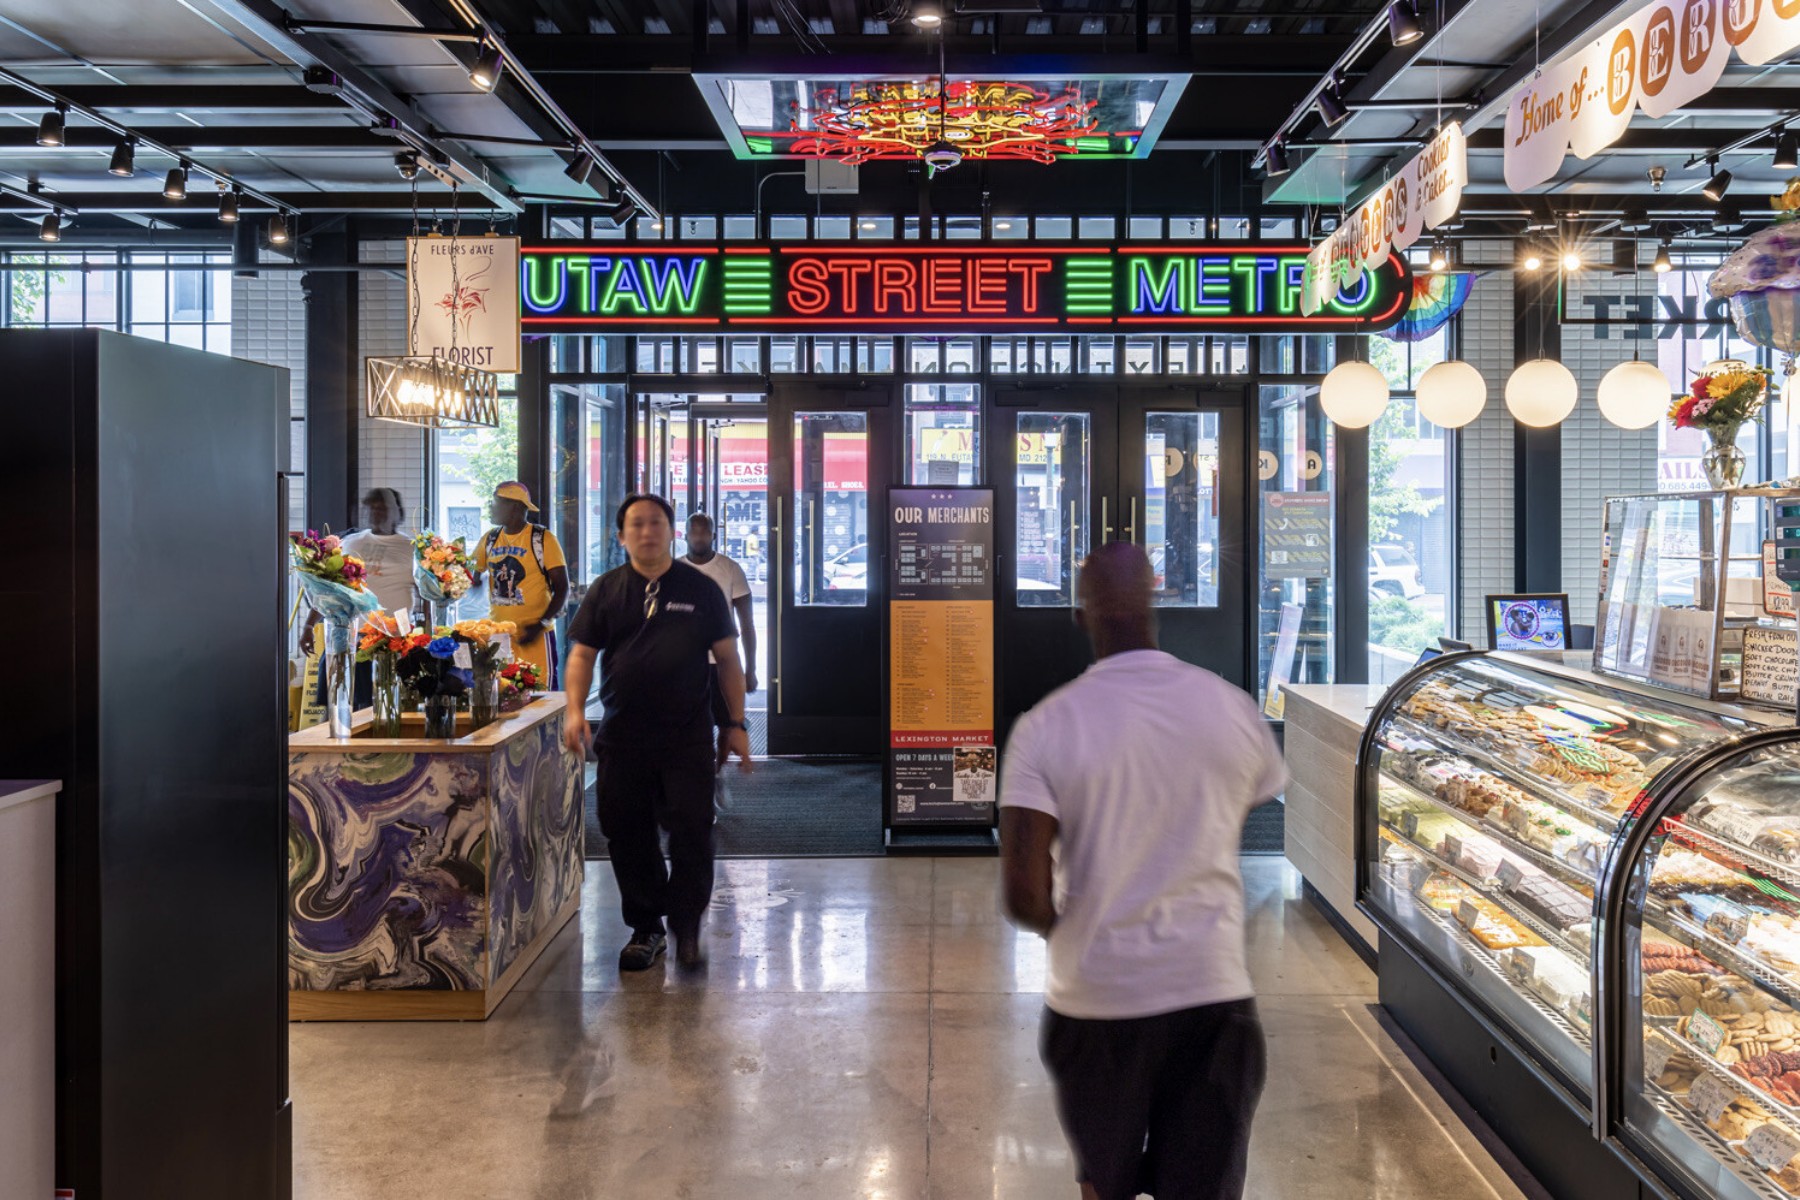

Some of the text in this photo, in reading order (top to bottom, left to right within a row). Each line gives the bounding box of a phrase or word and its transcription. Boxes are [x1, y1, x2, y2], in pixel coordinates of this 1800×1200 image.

[1515, 91, 1564, 147] Home
[1609, 0, 1797, 110] BER
[1417, 135, 1451, 182] Cookies
[431, 245, 466, 255] FLEURS
[787, 258, 1052, 314] STREET
[1019, 454, 1031, 462] MD
[895, 506, 989, 524] OUR MERCHANTS
[895, 753, 911, 761] OPEN
[918, 753, 932, 761] DAYS
[933, 753, 938, 761] A
